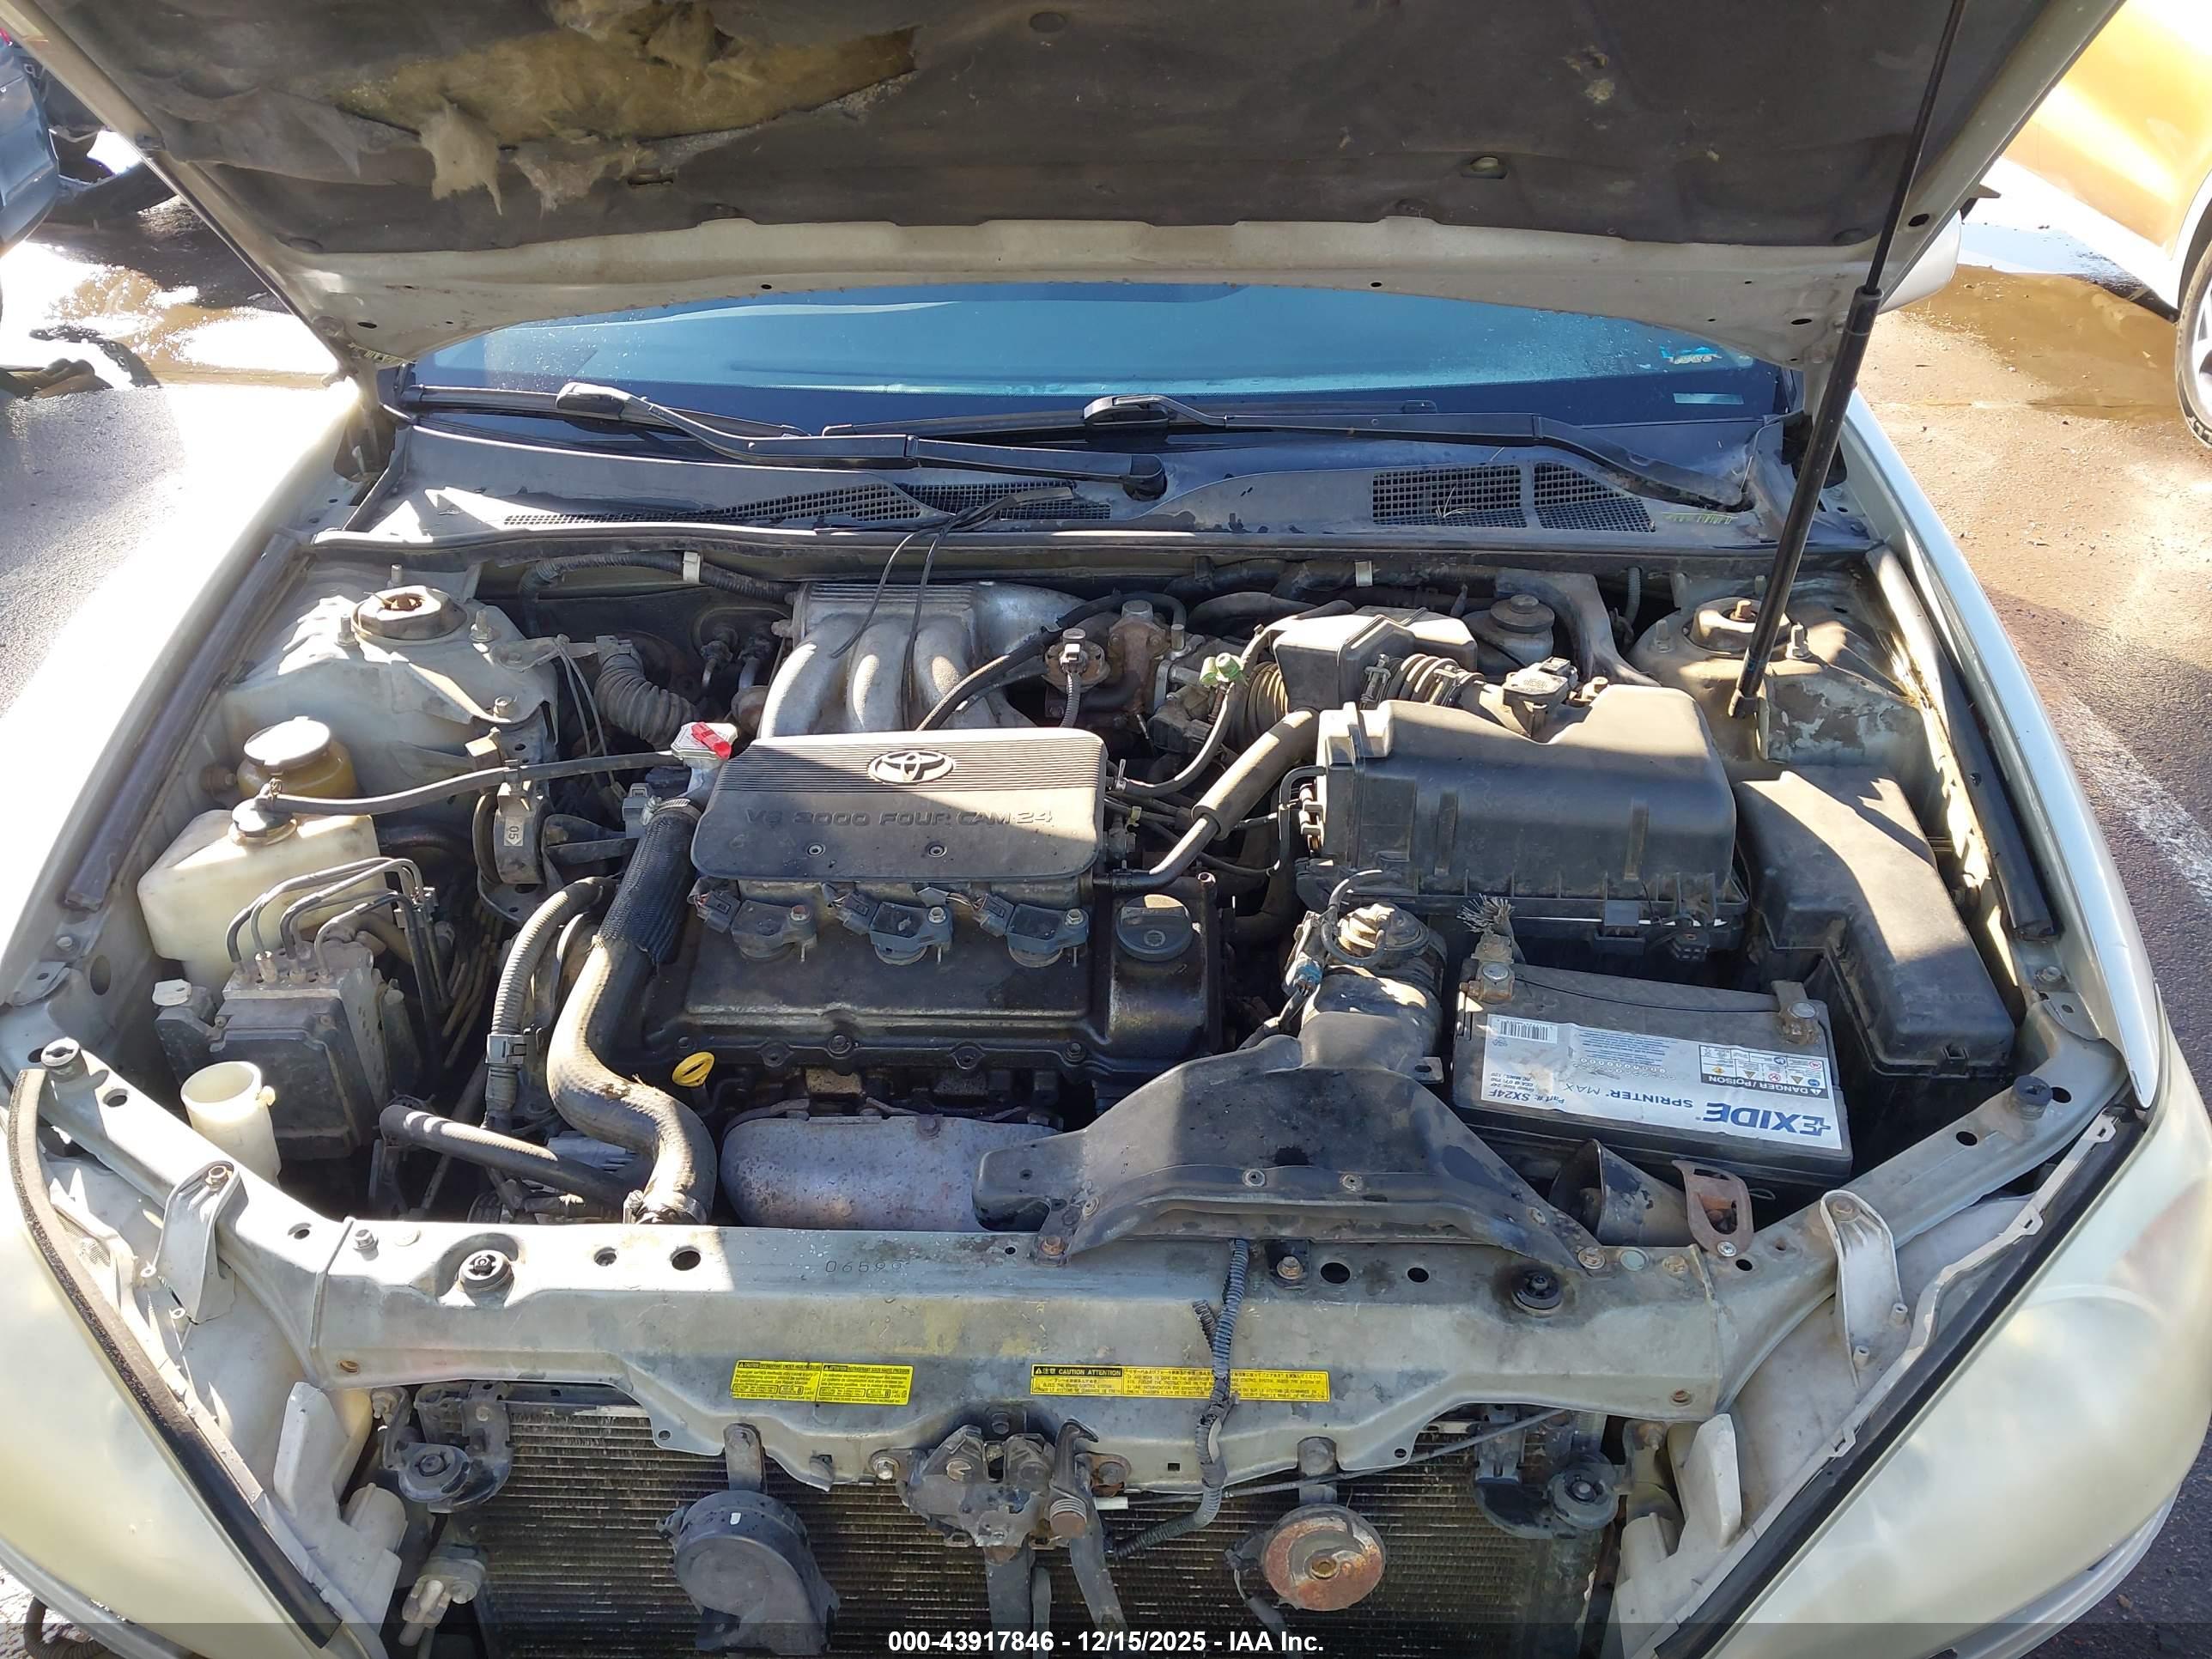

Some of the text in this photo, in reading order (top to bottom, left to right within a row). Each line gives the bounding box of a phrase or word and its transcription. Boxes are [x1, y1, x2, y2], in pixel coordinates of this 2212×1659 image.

[879, 811, 951, 826] FOUR
[957, 811, 1011, 826] CAM
[1017, 810, 1053, 824] 24
[508, 825, 520, 840] 05
[1564, 1083, 1601, 1096] MAX
[1759, 1082, 1808, 1094] DANGER
[1487, 1089, 1530, 1102] SX24F
[1545, 1094, 1565, 1104] Part
[1703, 1103, 1832, 1137] EXIDE
